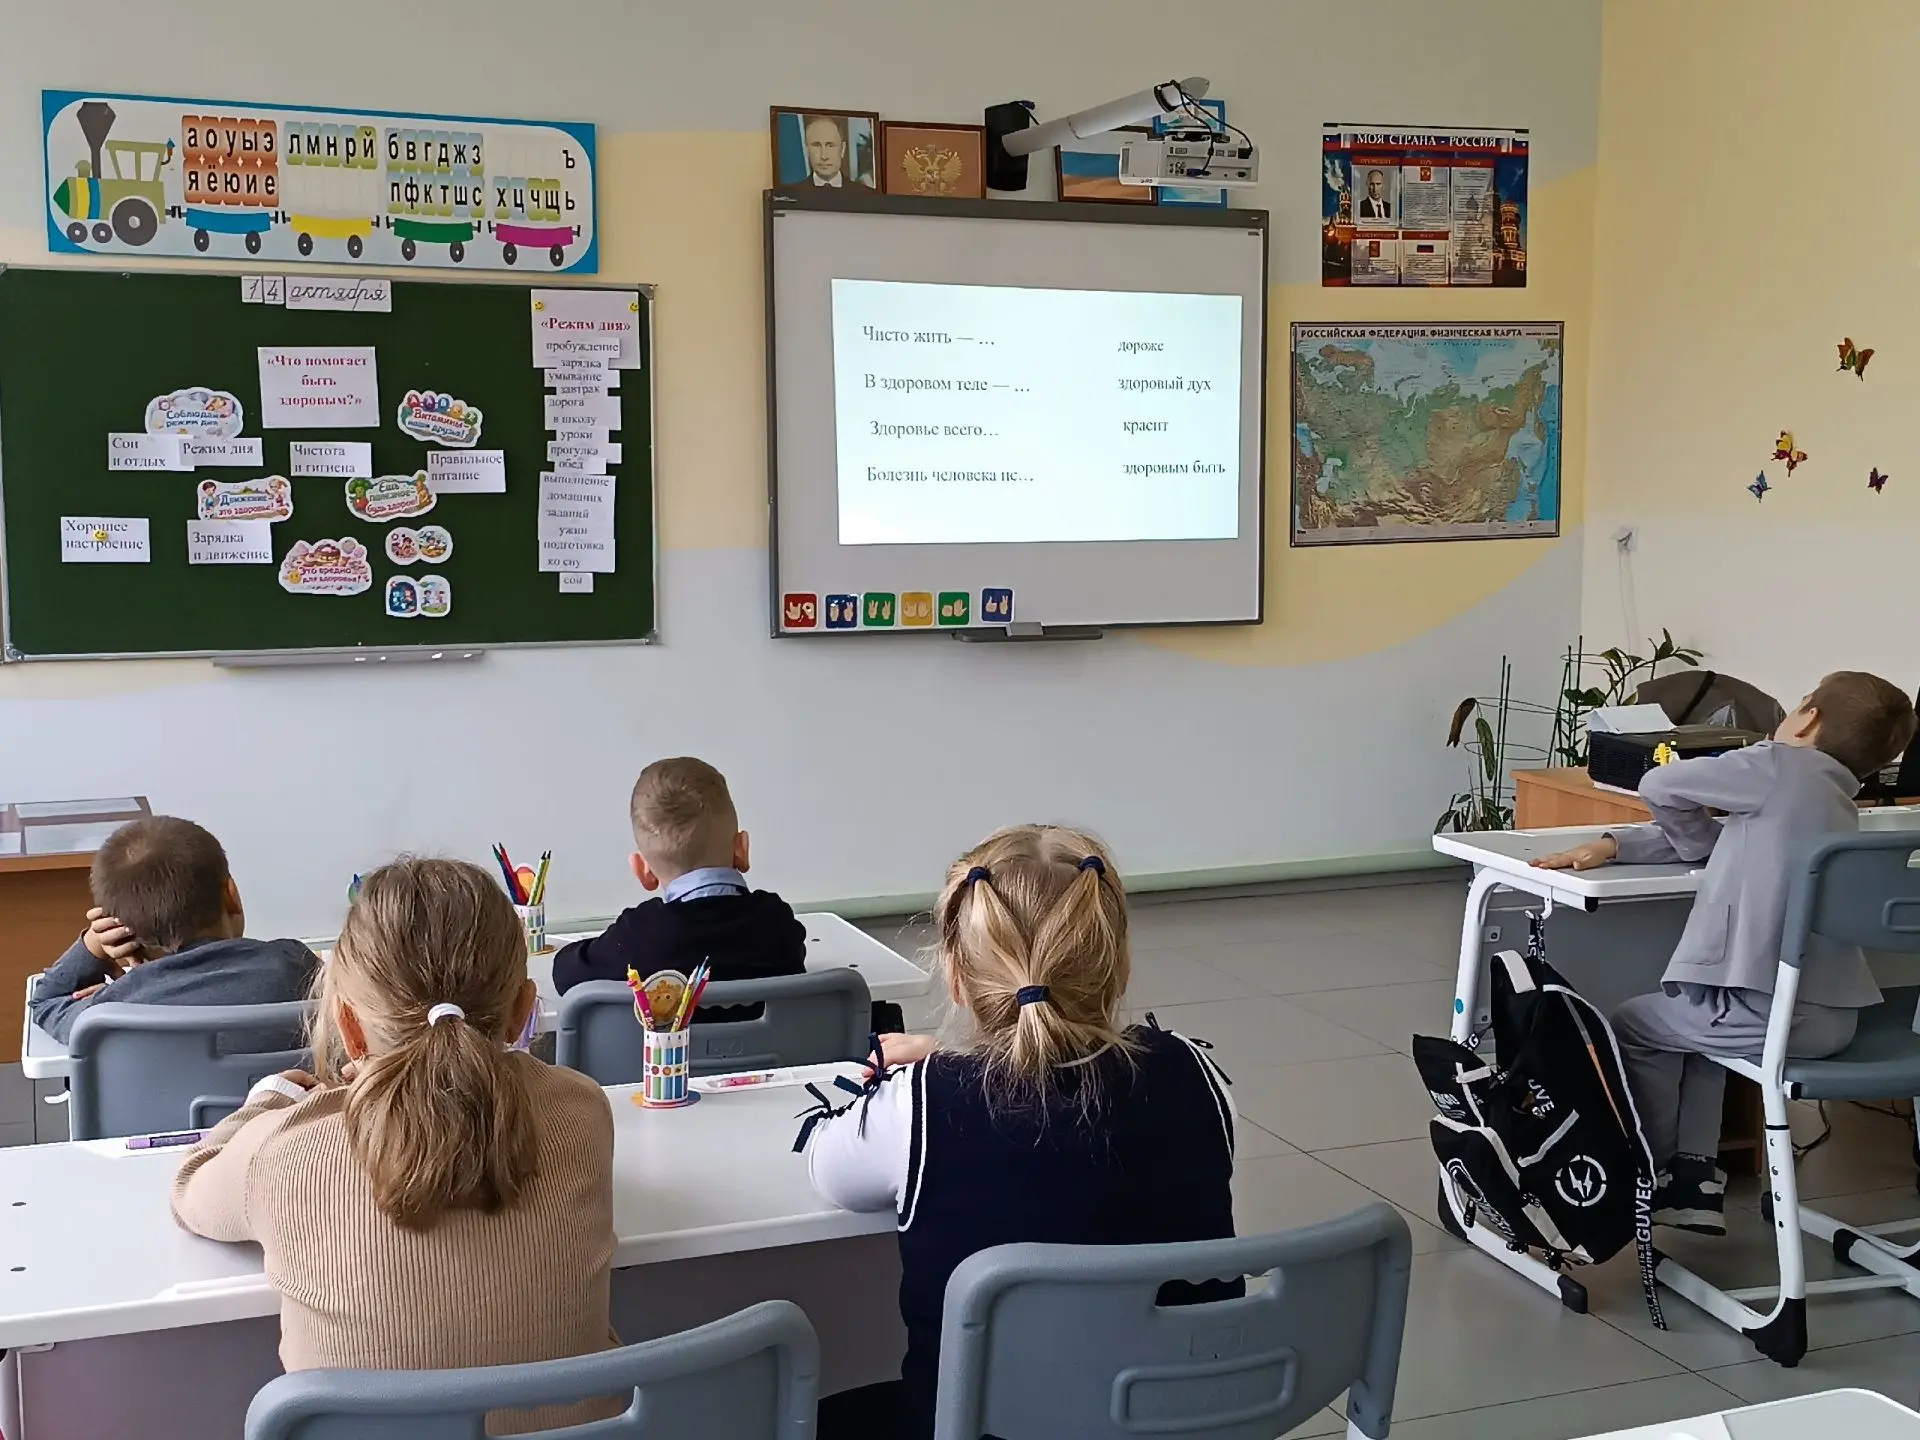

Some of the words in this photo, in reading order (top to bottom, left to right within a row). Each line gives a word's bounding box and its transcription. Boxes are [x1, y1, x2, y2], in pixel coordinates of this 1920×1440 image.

[1356, 132, 1384, 144] МОЯ
[1389, 134, 1436, 146] СТРАНА
[1449, 136, 1496, 147] РОССИЯ
[862, 325, 910, 342] Чисто
[913, 331, 952, 344] жить
[1300, 328, 1366, 338] РОССИЙСКАЯ
[1430, 328, 1492, 338] ФИЗИЧЕСКАЯ
[1494, 328, 1522, 337] КАРТА
[546, 340, 619, 353] пробуждение
[1118, 341, 1164, 355] дороже
[267, 355, 302, 366] «Что
[305, 357, 368, 367] помогает
[560, 360, 602, 370] зарядка
[301, 374, 337, 386] быть
[548, 372, 603, 383] умывание
[864, 373, 877, 389] В
[880, 377, 951, 394] здоровом
[956, 379, 988, 391] теле
[559, 385, 600, 396] завтрак
[1118, 376, 1184, 393] здоровый
[1186, 379, 1212, 394] дух
[279, 393, 362, 408] здоровым?»
[548, 399, 585, 409] дорога
[561, 416, 597, 426] школу
[870, 420, 940, 439] Здоровье
[1123, 421, 1169, 435] красит
[560, 431, 593, 442] уроки
[112, 437, 139, 450] Сон
[183, 443, 226, 455] Режим
[230, 445, 254, 455] дня
[294, 444, 346, 456] Чистота
[550, 446, 599, 458] прогулка
[112, 457, 121, 467] и
[124, 457, 167, 469] отдых
[430, 453, 503, 467] Правильное
[558, 458, 584, 470] обед
[294, 464, 302, 473] и
[305, 464, 356, 473] гигиена
[867, 466, 928, 482] Болезнь
[932, 470, 997, 482] человека
[1122, 463, 1189, 477] здоровым
[1192, 460, 1226, 474] быть
[431, 471, 481, 481] питание
[543, 475, 610, 487] выполнение
[546, 508, 590, 519] заданий
[65, 519, 129, 535] Хорошее
[558, 526, 588, 537] ужин
[192, 531, 244, 546] Зарядка
[66, 540, 144, 552] настроение
[543, 541, 605, 551] подготовка
[193, 551, 201, 560] и
[205, 550, 270, 560] движение
[547, 558, 560, 566] ко
[562, 558, 582, 569] сну
[563, 576, 583, 585] сон
